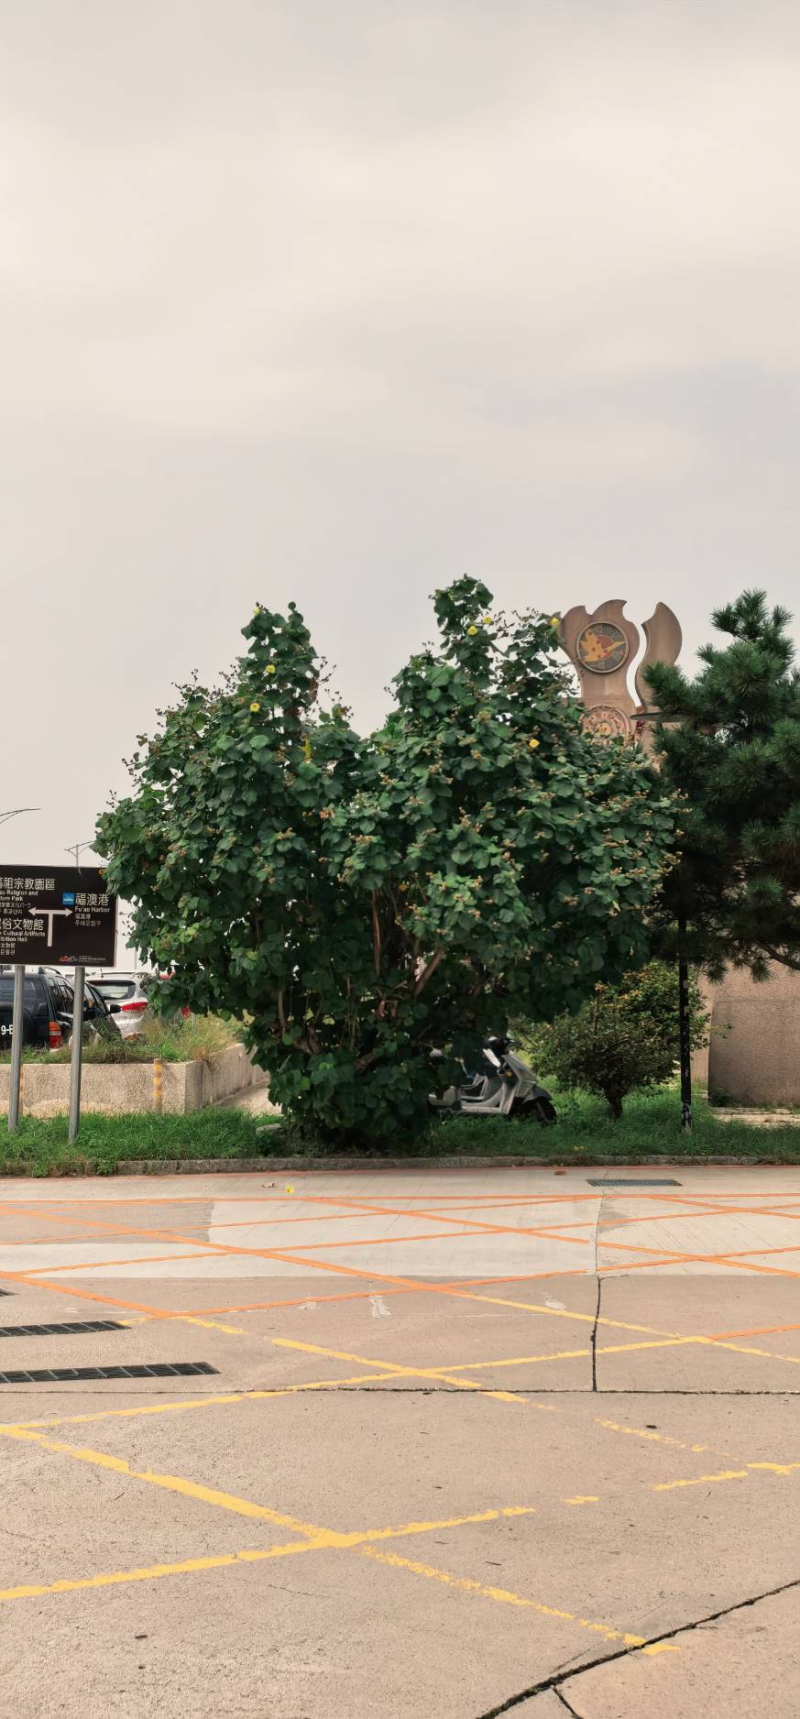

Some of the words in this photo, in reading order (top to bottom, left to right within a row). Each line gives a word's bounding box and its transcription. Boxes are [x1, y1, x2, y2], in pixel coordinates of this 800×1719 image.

[0, 877, 55, 890] 祖宗教園區
[75, 892, 109, 906] 福澳港
[0, 918, 44, 930] 俗文物館
